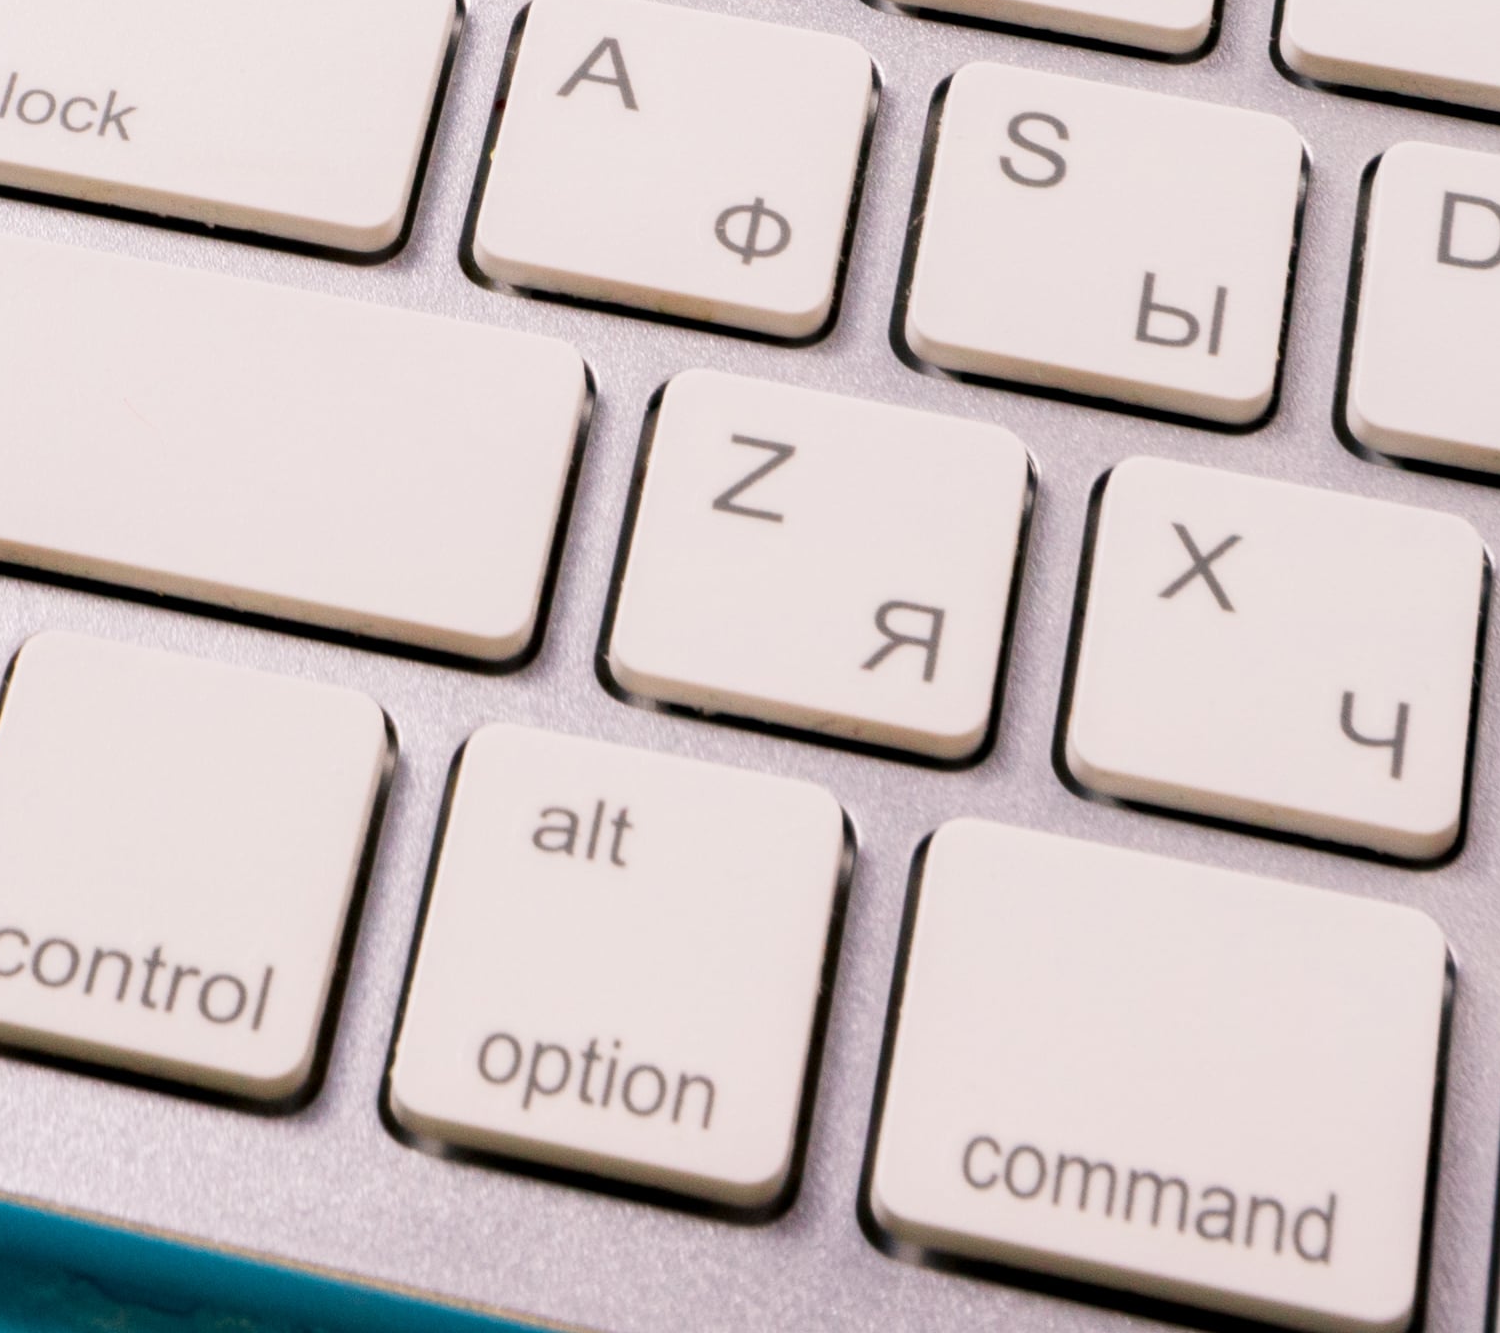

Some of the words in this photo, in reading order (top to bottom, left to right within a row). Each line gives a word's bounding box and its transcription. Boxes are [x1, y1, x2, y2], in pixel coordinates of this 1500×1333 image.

[556, 36, 639, 111] A
[999, 111, 1070, 189] S
[711, 433, 796, 524] Z
[1159, 523, 1242, 613] X
[531, 799, 632, 868] alt
[476, 1031, 717, 1130] option
[960, 1134, 1337, 1264] command
